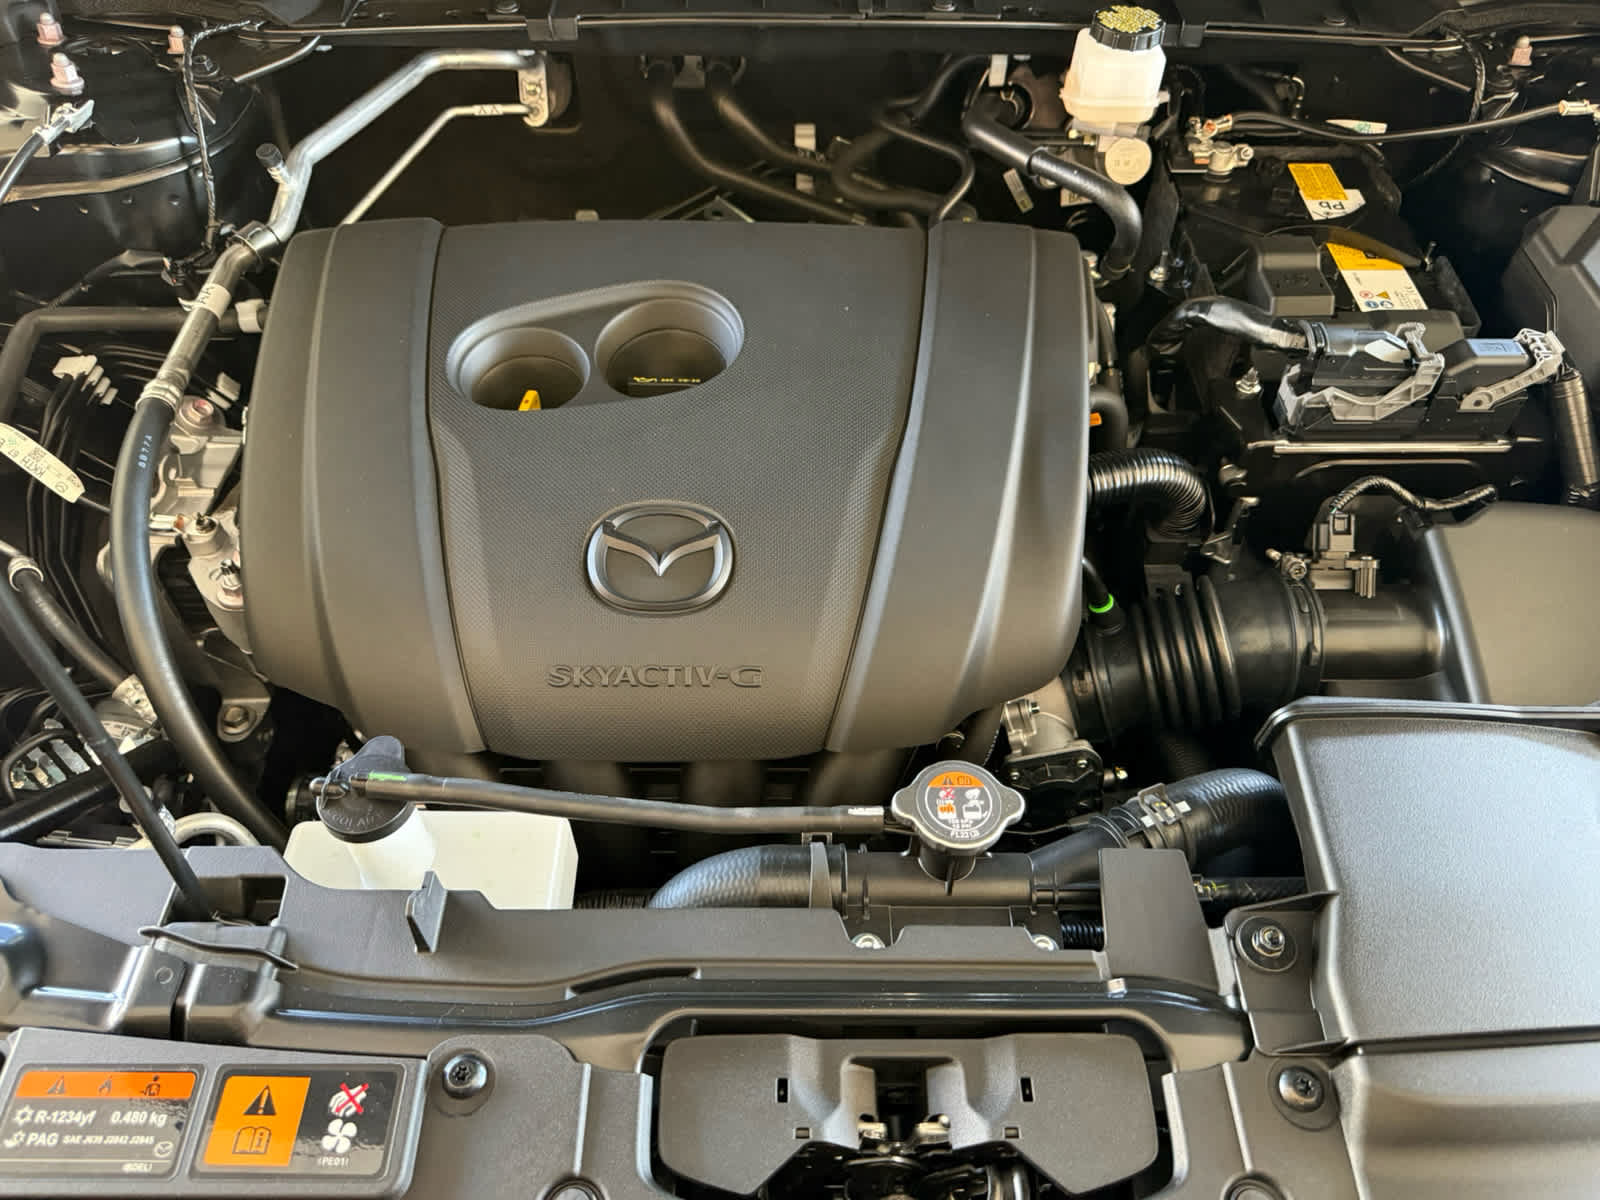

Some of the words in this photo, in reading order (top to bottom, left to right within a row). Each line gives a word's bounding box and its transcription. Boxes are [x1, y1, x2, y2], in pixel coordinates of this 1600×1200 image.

[1318, 200, 1345, 211] Pb
[547, 663, 764, 689] SKYACTIV-G
[34, 1110, 97, 1127] R-1234yf
[110, 1111, 147, 1124] 0.480
[149, 1111, 168, 1128] kg
[26, 1132, 59, 1146] PAG
[62, 1135, 82, 1145] SAE
